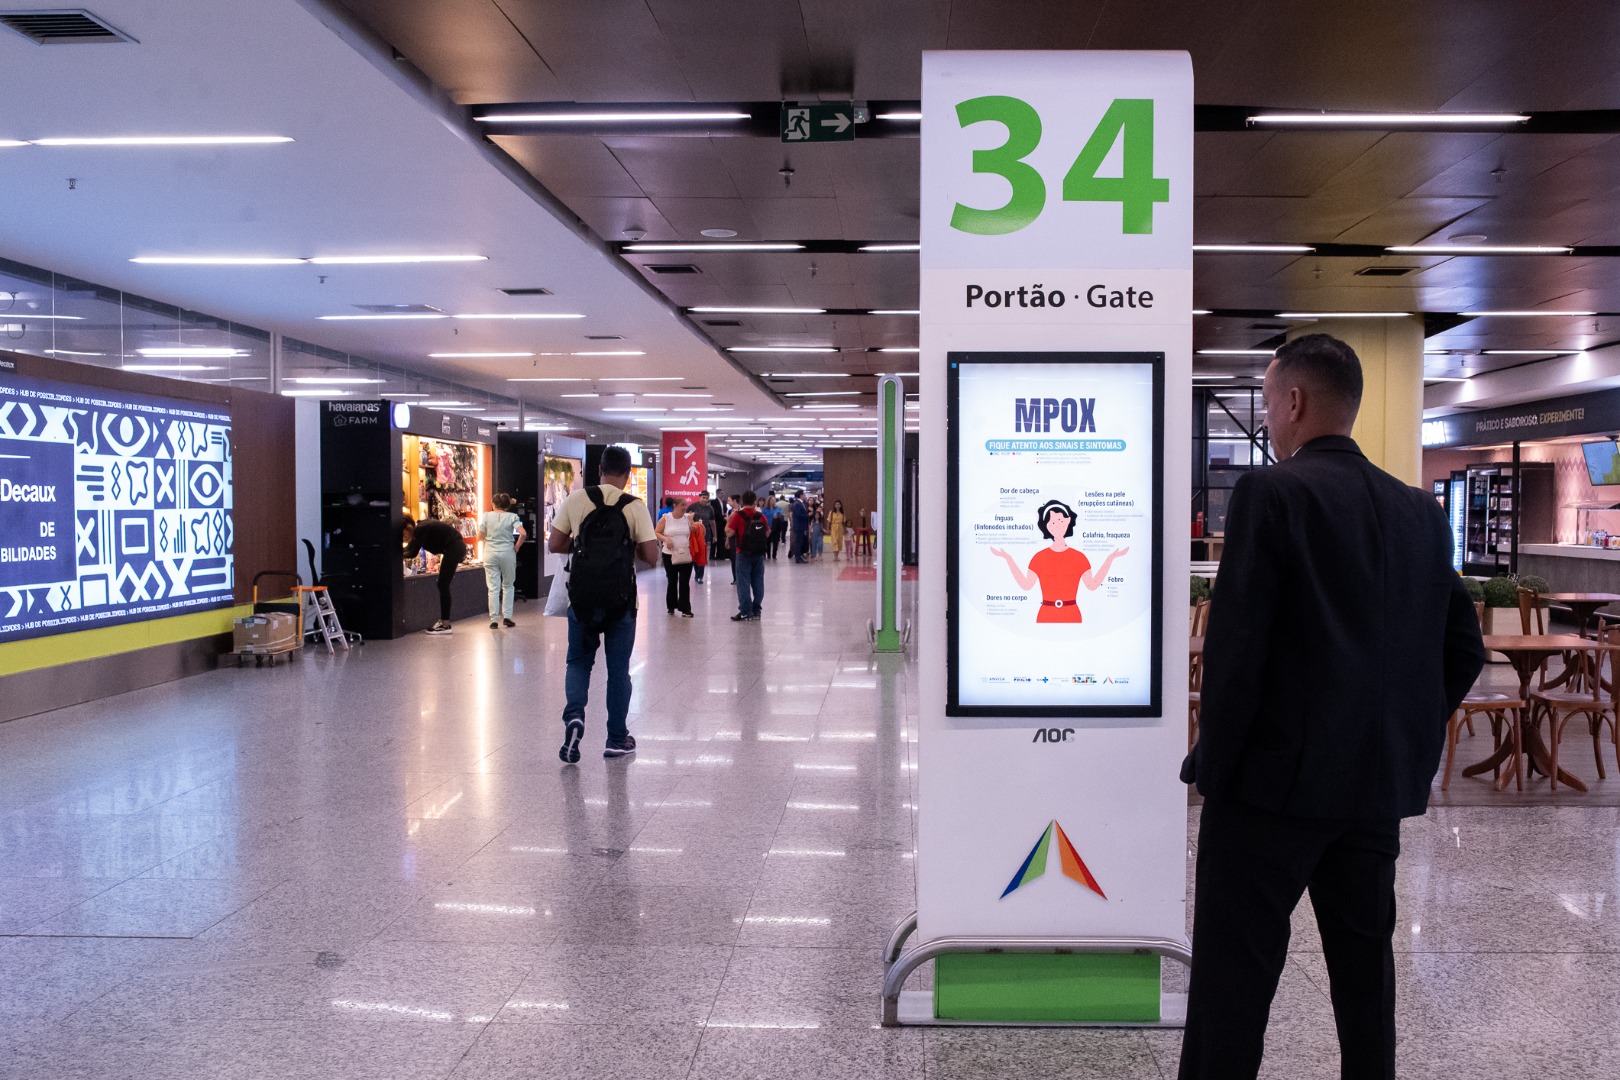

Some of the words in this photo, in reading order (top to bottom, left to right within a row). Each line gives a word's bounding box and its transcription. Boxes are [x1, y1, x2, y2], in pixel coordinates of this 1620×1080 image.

[950, 95, 1169, 235] 34
[966, 284, 1066, 309] Portão
[1087, 285, 1154, 309] Gate
[349, 416, 378, 424] FARM
[1015, 398, 1096, 433] MPOX
[989, 441, 1010, 450] FIQUE
[1011, 441, 1038, 450] ATENTO
[1040, 441, 1054, 450] AOS
[1055, 441, 1079, 450] SINAIS
[1080, 441, 1085, 450] E
[1085, 441, 1122, 450] SINTOMAS
[0, 478, 56, 502] Decaux
[1019, 487, 1040, 495] cabeça
[1113, 491, 1126, 499] pele
[995, 514, 1014, 522] Ínguas
[40, 521, 56, 538] DE
[1106, 532, 1131, 540] fraqueza
